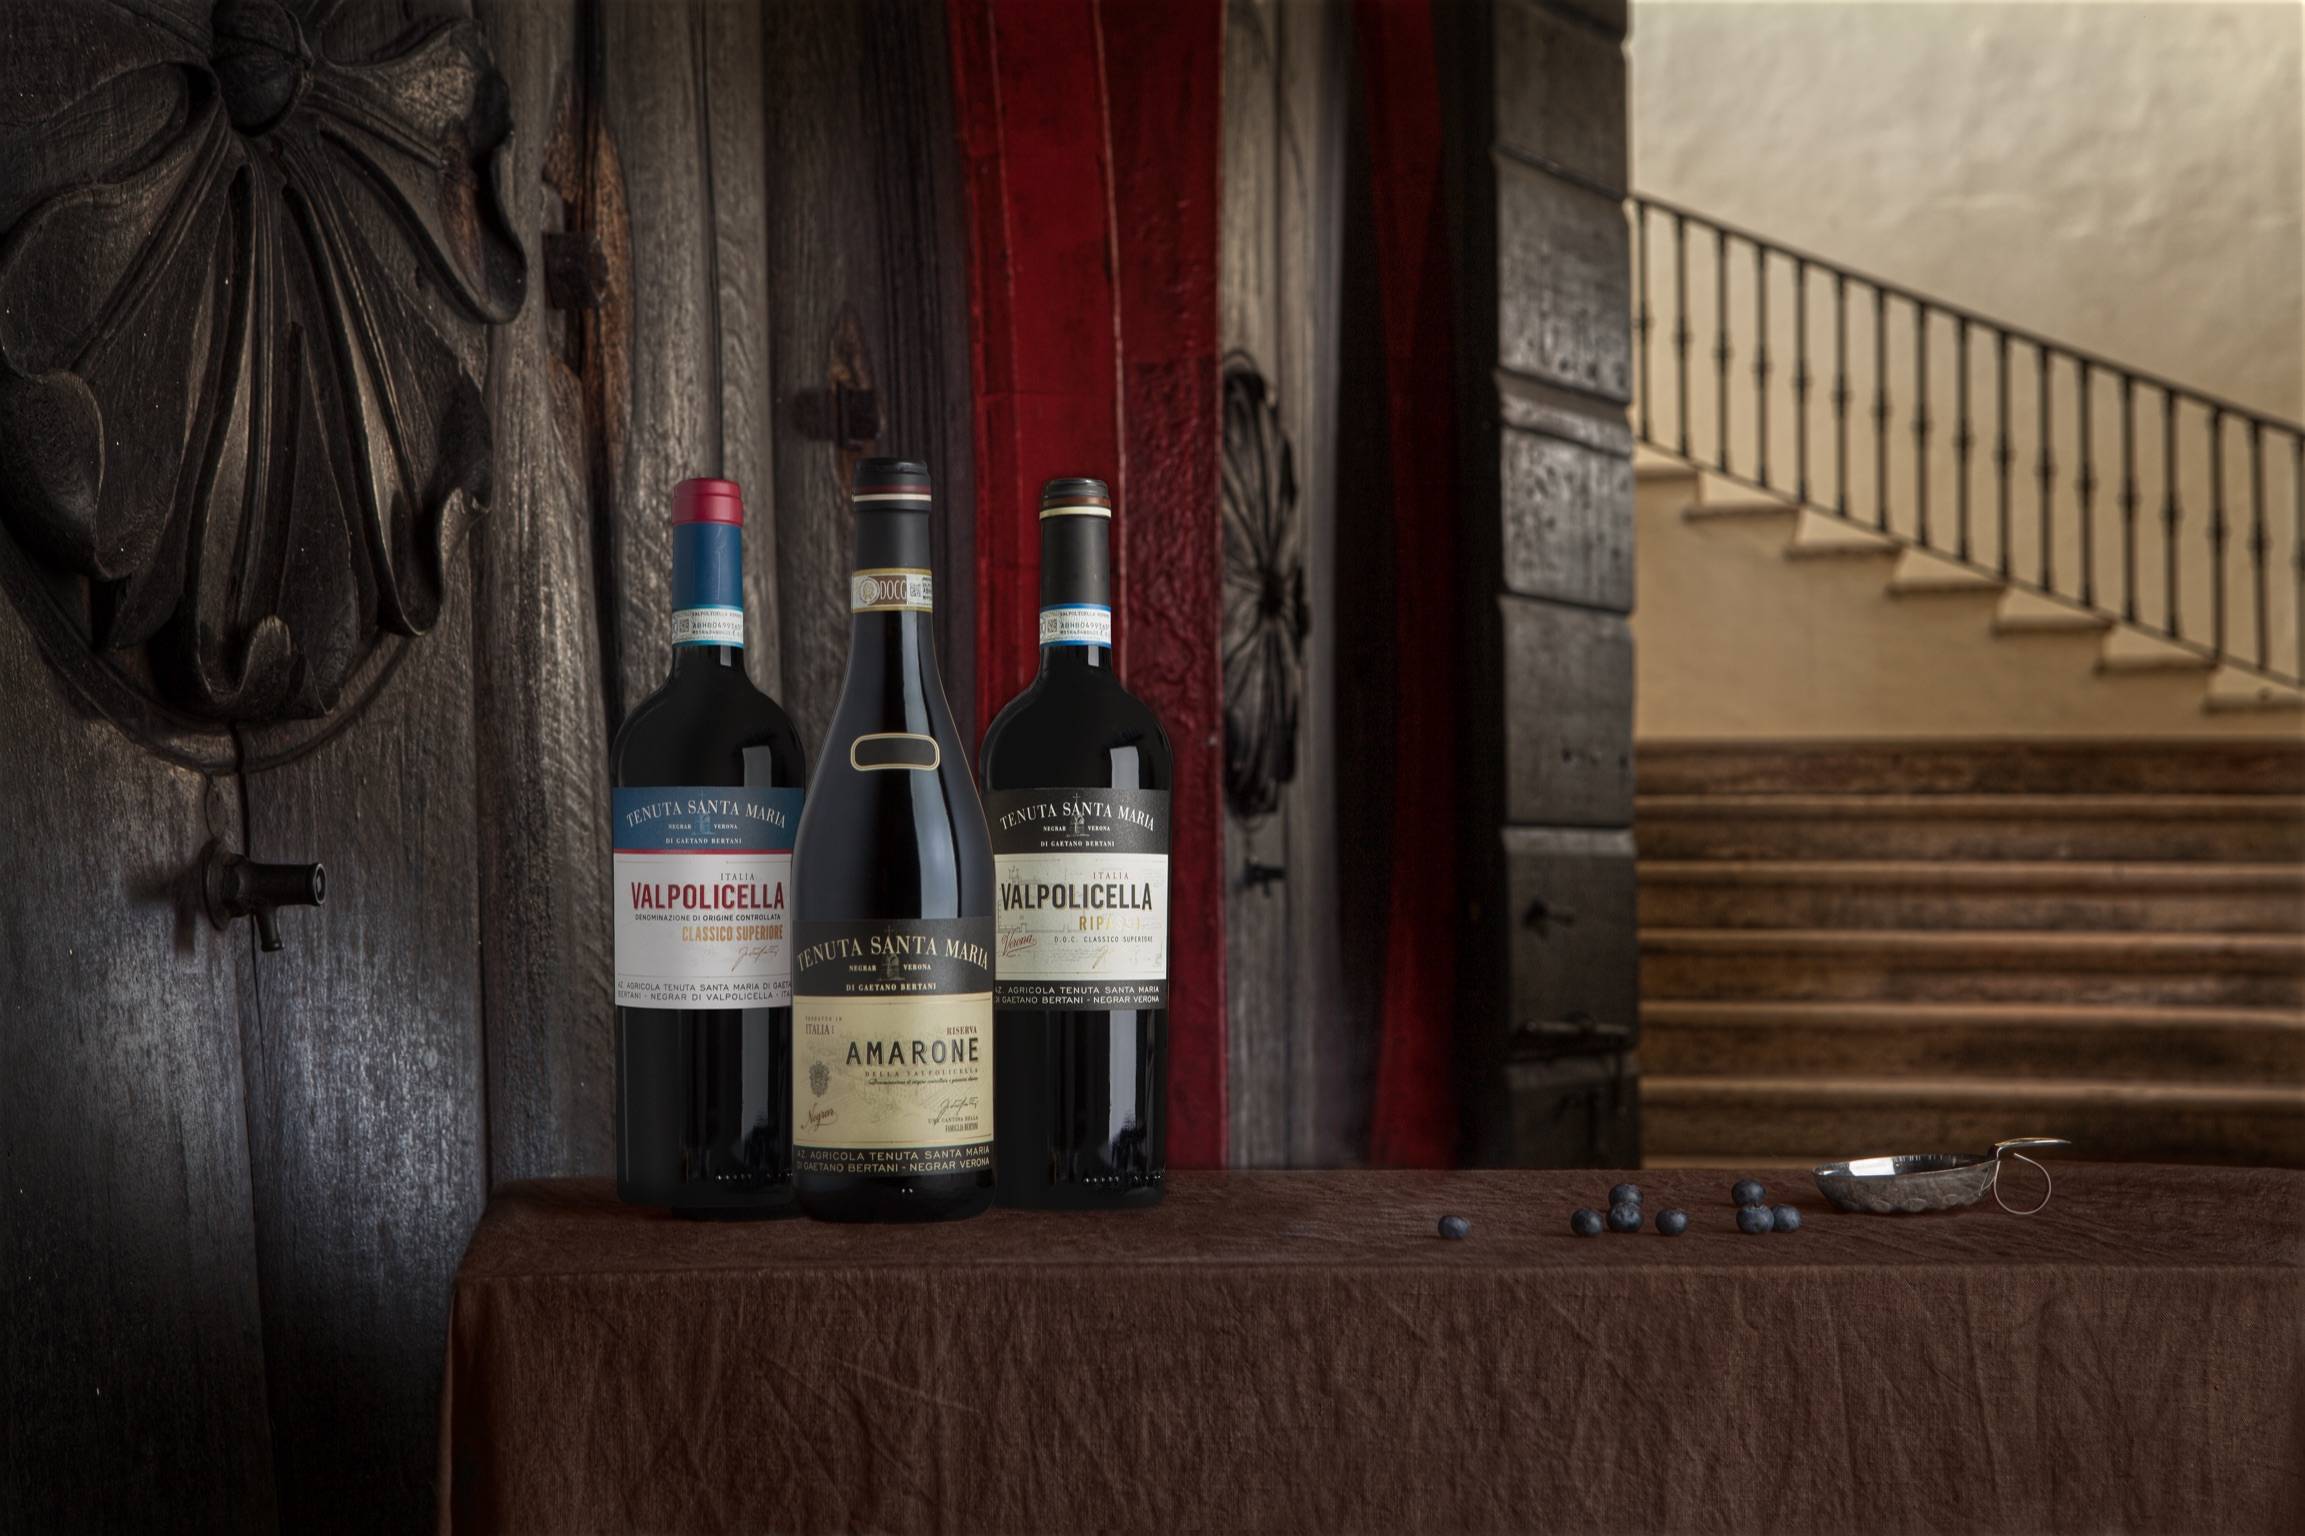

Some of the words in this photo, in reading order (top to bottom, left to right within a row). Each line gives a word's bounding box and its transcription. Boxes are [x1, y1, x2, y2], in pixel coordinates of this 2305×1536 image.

[879, 580, 907, 600] DOCG
[626, 801, 682, 828] TENUTA
[687, 799, 739, 816] SANTA
[745, 803, 786, 829] MARIA
[1000, 803, 1057, 831] TENUTA
[1062, 801, 1112, 818] SANTA
[1118, 805, 1154, 832] MARIA
[720, 872, 755, 881] ITALIA
[1092, 871, 1129, 880] ITALIA
[631, 881, 785, 910] VALPOLICELLA
[1001, 882, 1152, 911] VALPOLICELLA
[634, 913, 691, 922] DENOMINAZIONE
[692, 914, 701, 922] DI
[702, 914, 734, 922] ORIGINE
[735, 913, 781, 922] CONTROLLATA
[682, 926, 733, 942] CLASSICO
[736, 924, 783, 941] SUPERIORE
[1083, 935, 1119, 943] CLASSICO
[1123, 935, 1153, 943] SUPERIORE
[798, 937, 863, 972] TENUTA
[869, 935, 938, 956] SANTA
[945, 938, 988, 971] MARIA
[849, 964, 877, 972] NEGRAR
[903, 963, 931, 971] VERONA
[626, 981, 660, 992] AGRICOLA
[663, 983, 696, 992] TENUTA
[700, 983, 730, 992] SANTA
[733, 983, 760, 991] MARIA
[763, 982, 771, 990] DI
[858, 983, 897, 991] GAETANO
[900, 982, 937, 991] BERTANI
[1007, 986, 1056, 995] AGRICOLA
[1060, 986, 1100, 994] TENUTA
[1104, 985, 1135, 994] SANTA
[1138, 985, 1160, 993] MARIA
[650, 992, 687, 1001] NEGRAR
[691, 992, 701, 1001] DI
[706, 991, 773, 1001] VALPOLICELLA
[1002, 995, 1038, 1004] GAETANO
[1041, 996, 1084, 1005] BERTANI
[1093, 995, 1131, 1004] NEGRAR
[1133, 995, 1160, 1003] VERONA
[946, 1026, 978, 1035] RISERVA
[845, 1037, 979, 1065] AMARONE
[809, 1150, 864, 1161] AGRICOLA
[869, 1151, 919, 1161] TENUTA
[924, 1149, 961, 1159] SANTA
[966, 1145, 990, 1156] MARIA
[803, 1162, 844, 1173] GAETANO
[848, 1163, 899, 1173] BERTANI
[909, 1161, 956, 1172] NEGRAR
[959, 1157, 990, 1169] VERONA
